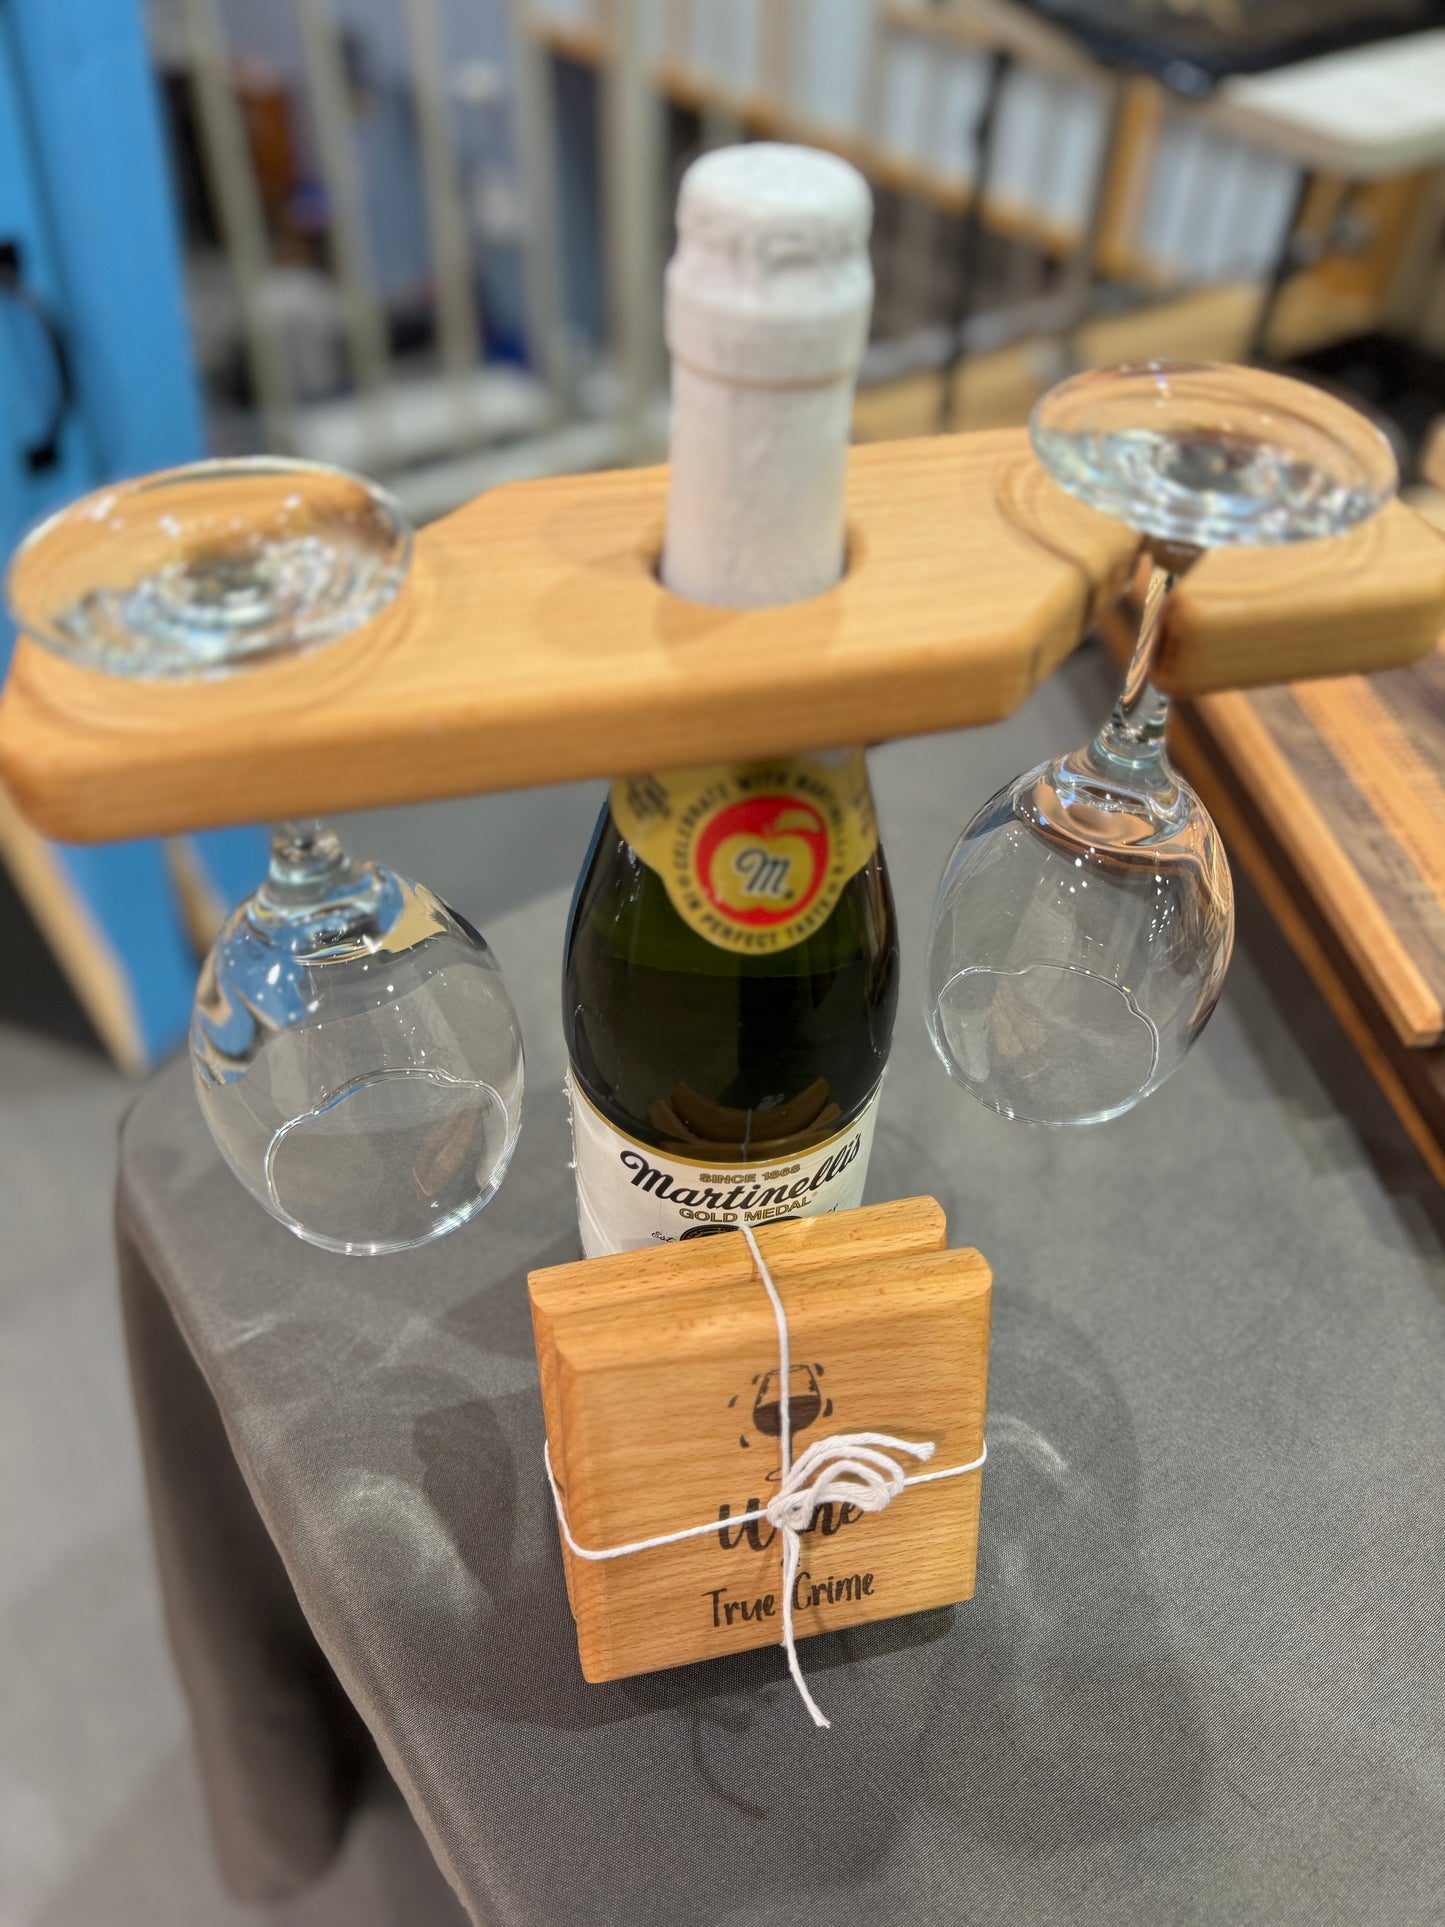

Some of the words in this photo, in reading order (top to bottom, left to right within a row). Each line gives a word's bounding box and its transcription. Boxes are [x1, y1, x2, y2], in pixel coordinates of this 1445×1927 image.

[701, 910, 779, 949] PERFECT
[786, 898, 832, 941] TASTE
[620, 1132, 863, 1210] Martinelli's
[699, 1171, 757, 1185] SINCE
[761, 1163, 801, 1181] 1868
[678, 1207, 738, 1223] GOLD
[744, 1197, 811, 1222] MEDAL
[702, 1587, 777, 1627] True
[793, 1571, 875, 1611] Crime
